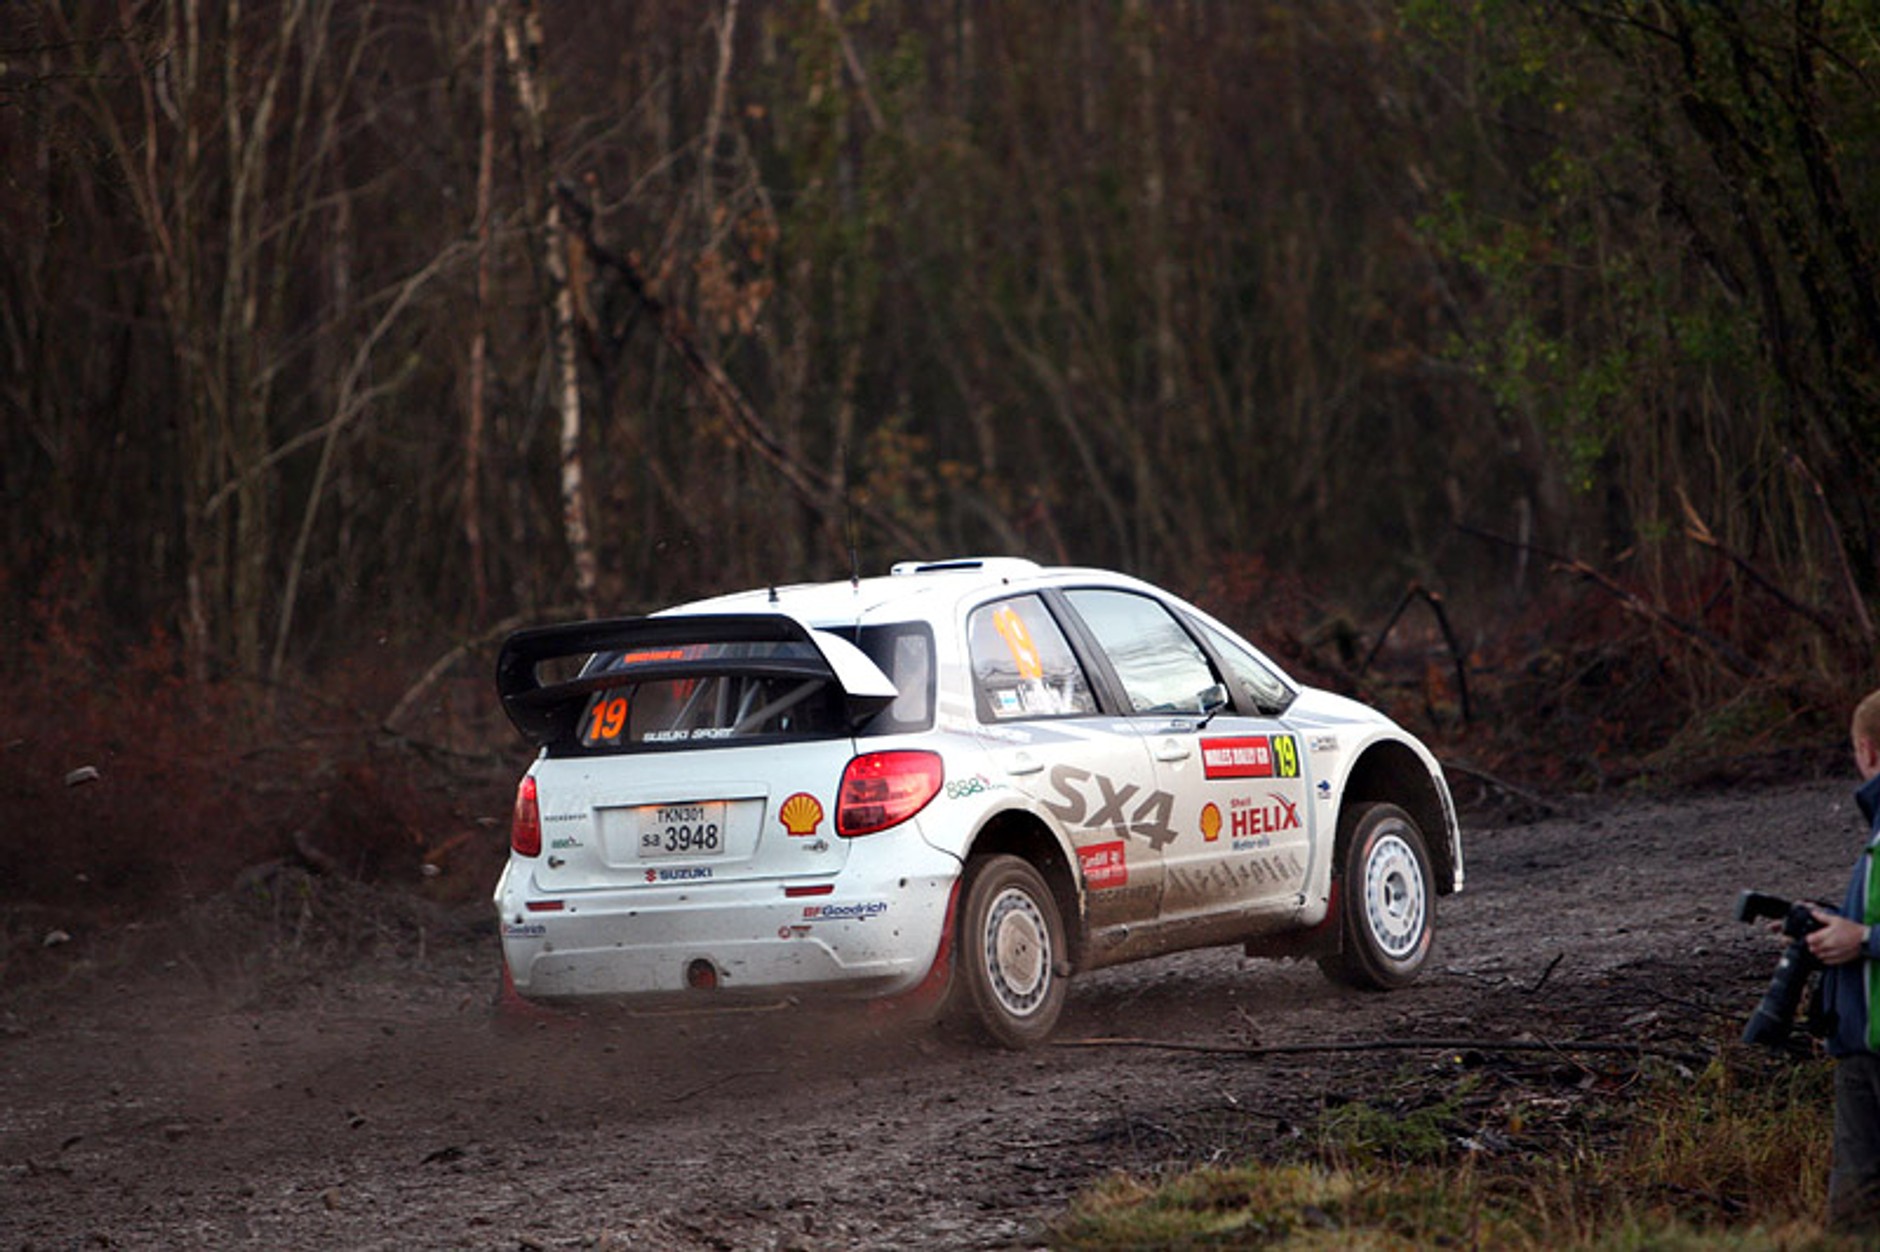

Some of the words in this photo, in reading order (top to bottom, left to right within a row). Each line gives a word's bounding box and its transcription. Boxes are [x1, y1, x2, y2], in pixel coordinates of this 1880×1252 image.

[993, 606, 1043, 679] 19
[590, 698, 627, 740] 19
[642, 729, 689, 742] SUZUKI
[692, 727, 735, 739] SPORT
[1274, 736, 1297, 777] 19
[657, 807, 704, 823] TKN301
[1042, 764, 1178, 851] SX4
[1231, 801, 1299, 837] HELIX
[664, 824, 718, 851] 3948
[660, 868, 713, 880] SUZUKI
